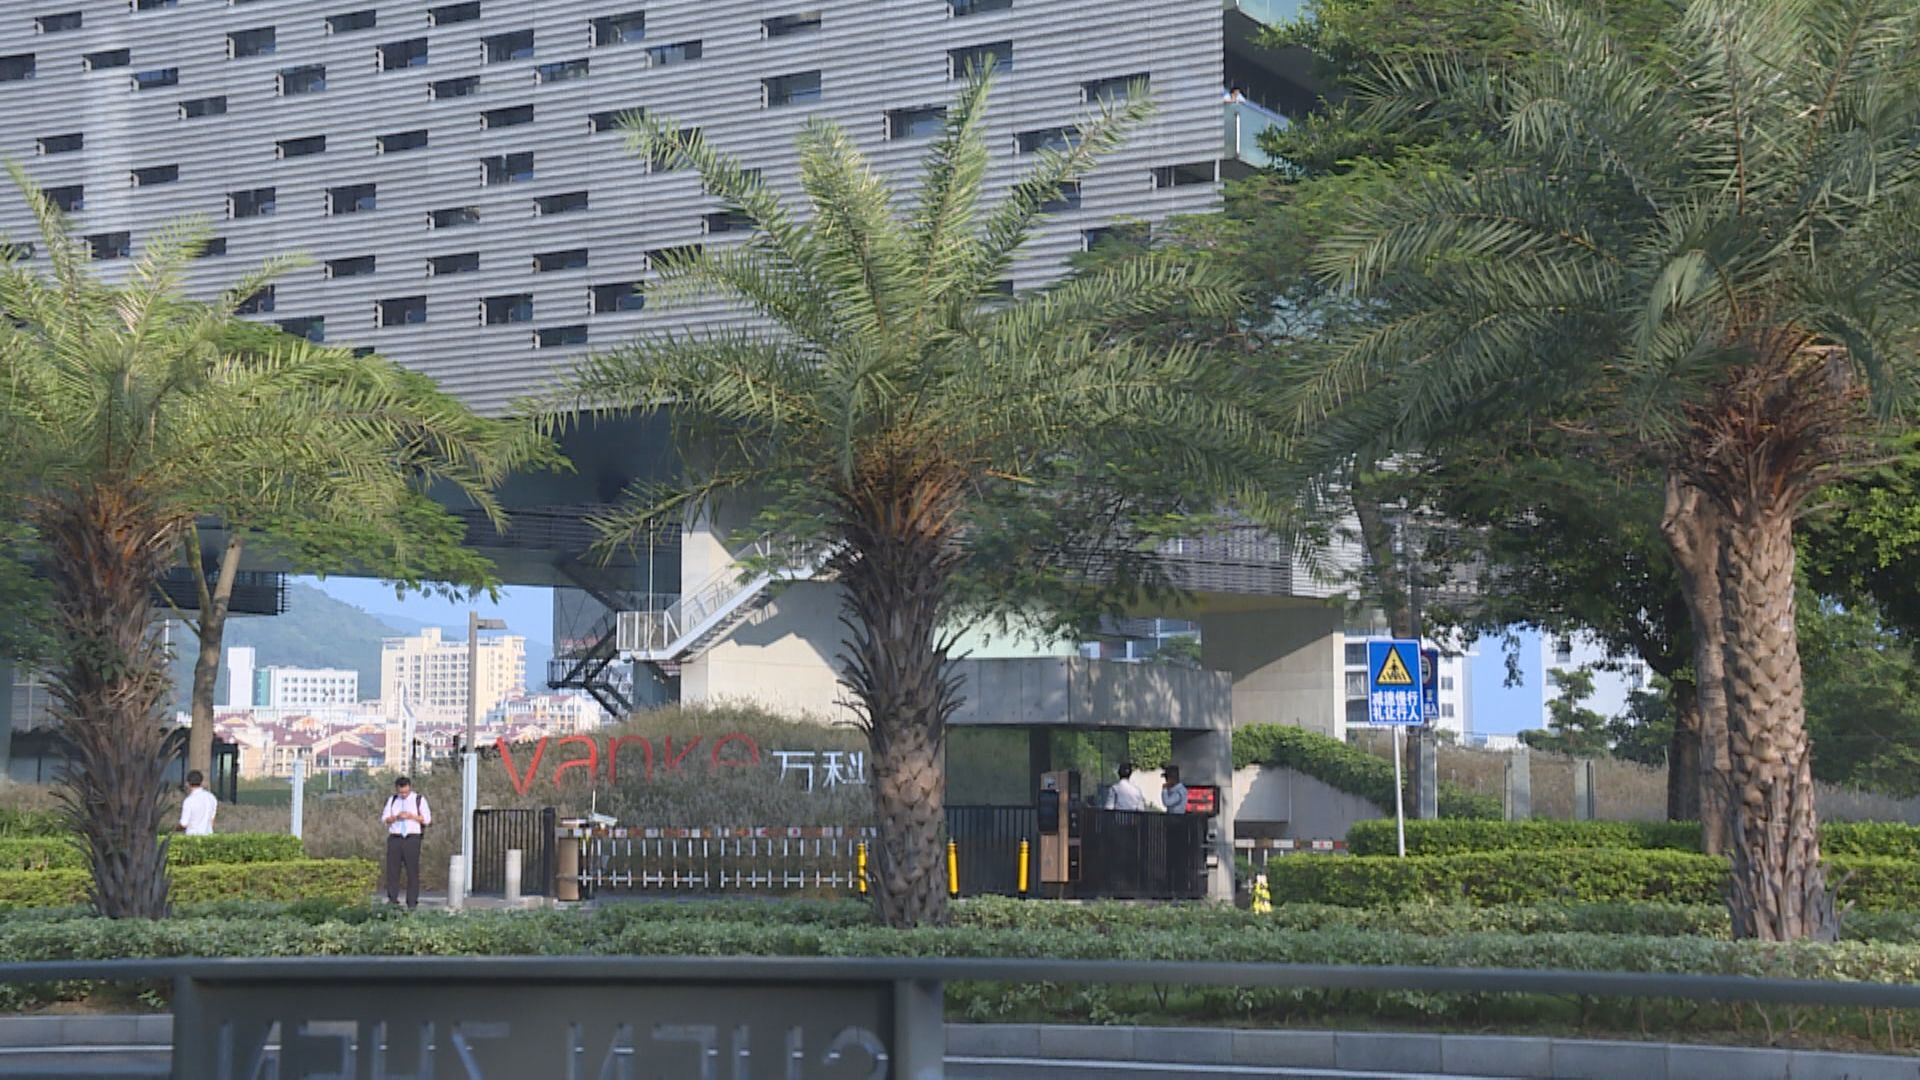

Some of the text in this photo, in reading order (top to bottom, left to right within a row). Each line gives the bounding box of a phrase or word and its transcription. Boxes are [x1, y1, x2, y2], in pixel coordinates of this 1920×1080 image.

[1372, 689, 1418, 706] 减速慢行
[496, 732, 866, 797] vanke 万科
